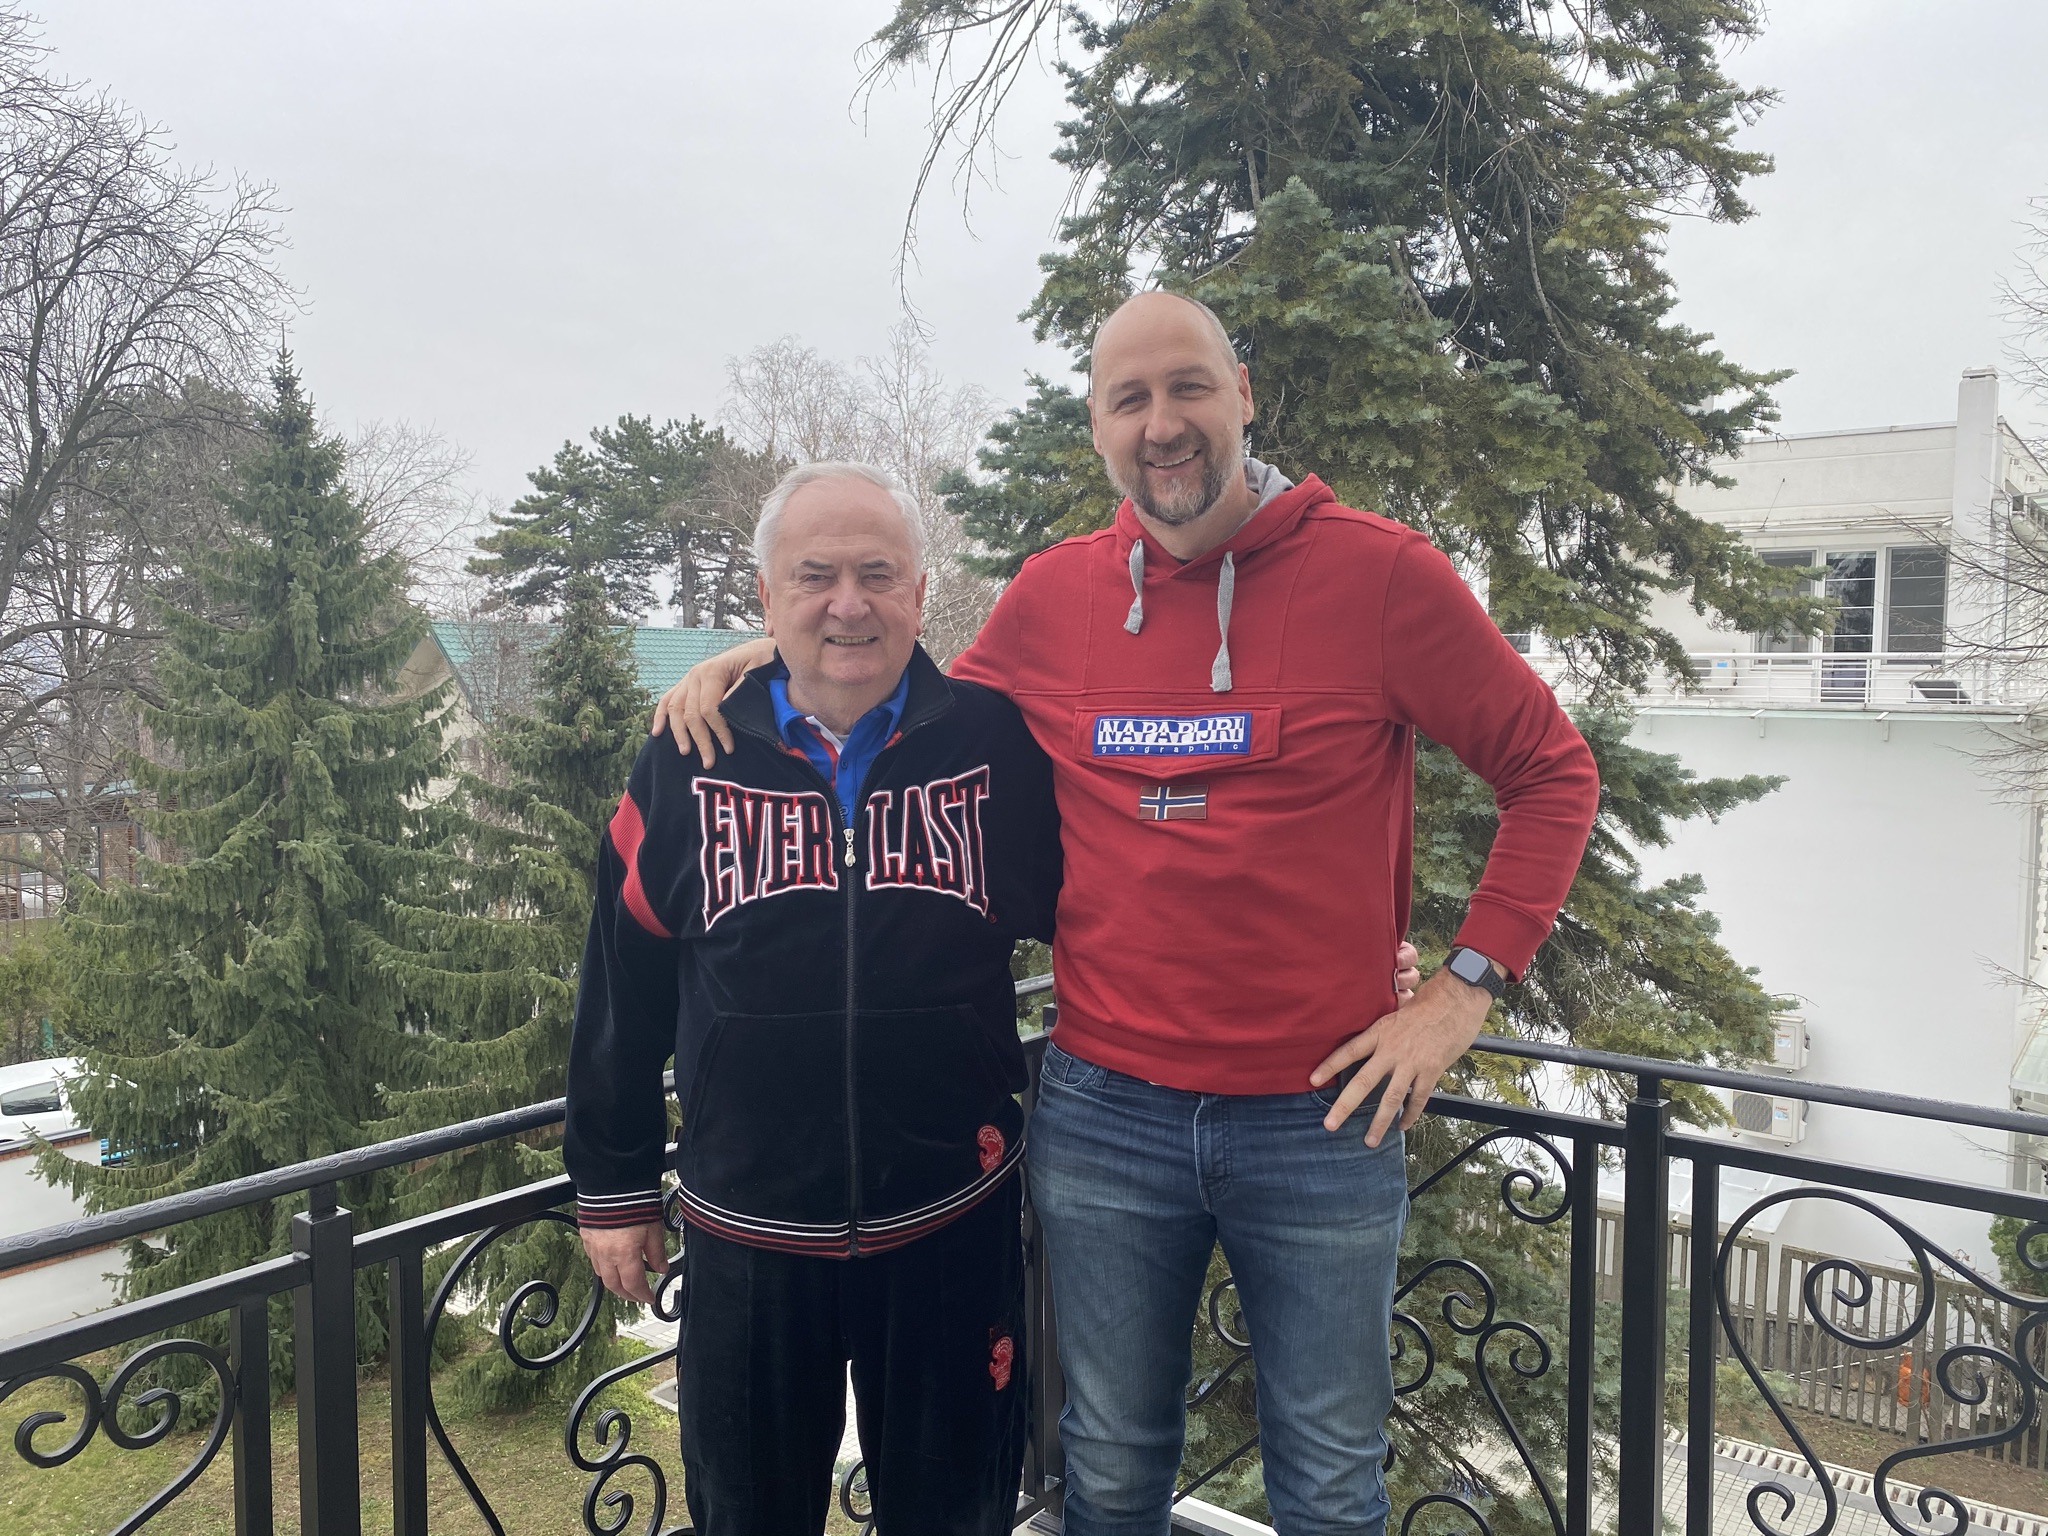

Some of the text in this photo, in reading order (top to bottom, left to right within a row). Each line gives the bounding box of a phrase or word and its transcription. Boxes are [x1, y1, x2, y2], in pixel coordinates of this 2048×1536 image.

[1101, 717, 1243, 743] NAPAPIJRI
[1102, 743, 1239, 753] geographic
[691, 764, 990, 932] EVER LAST
